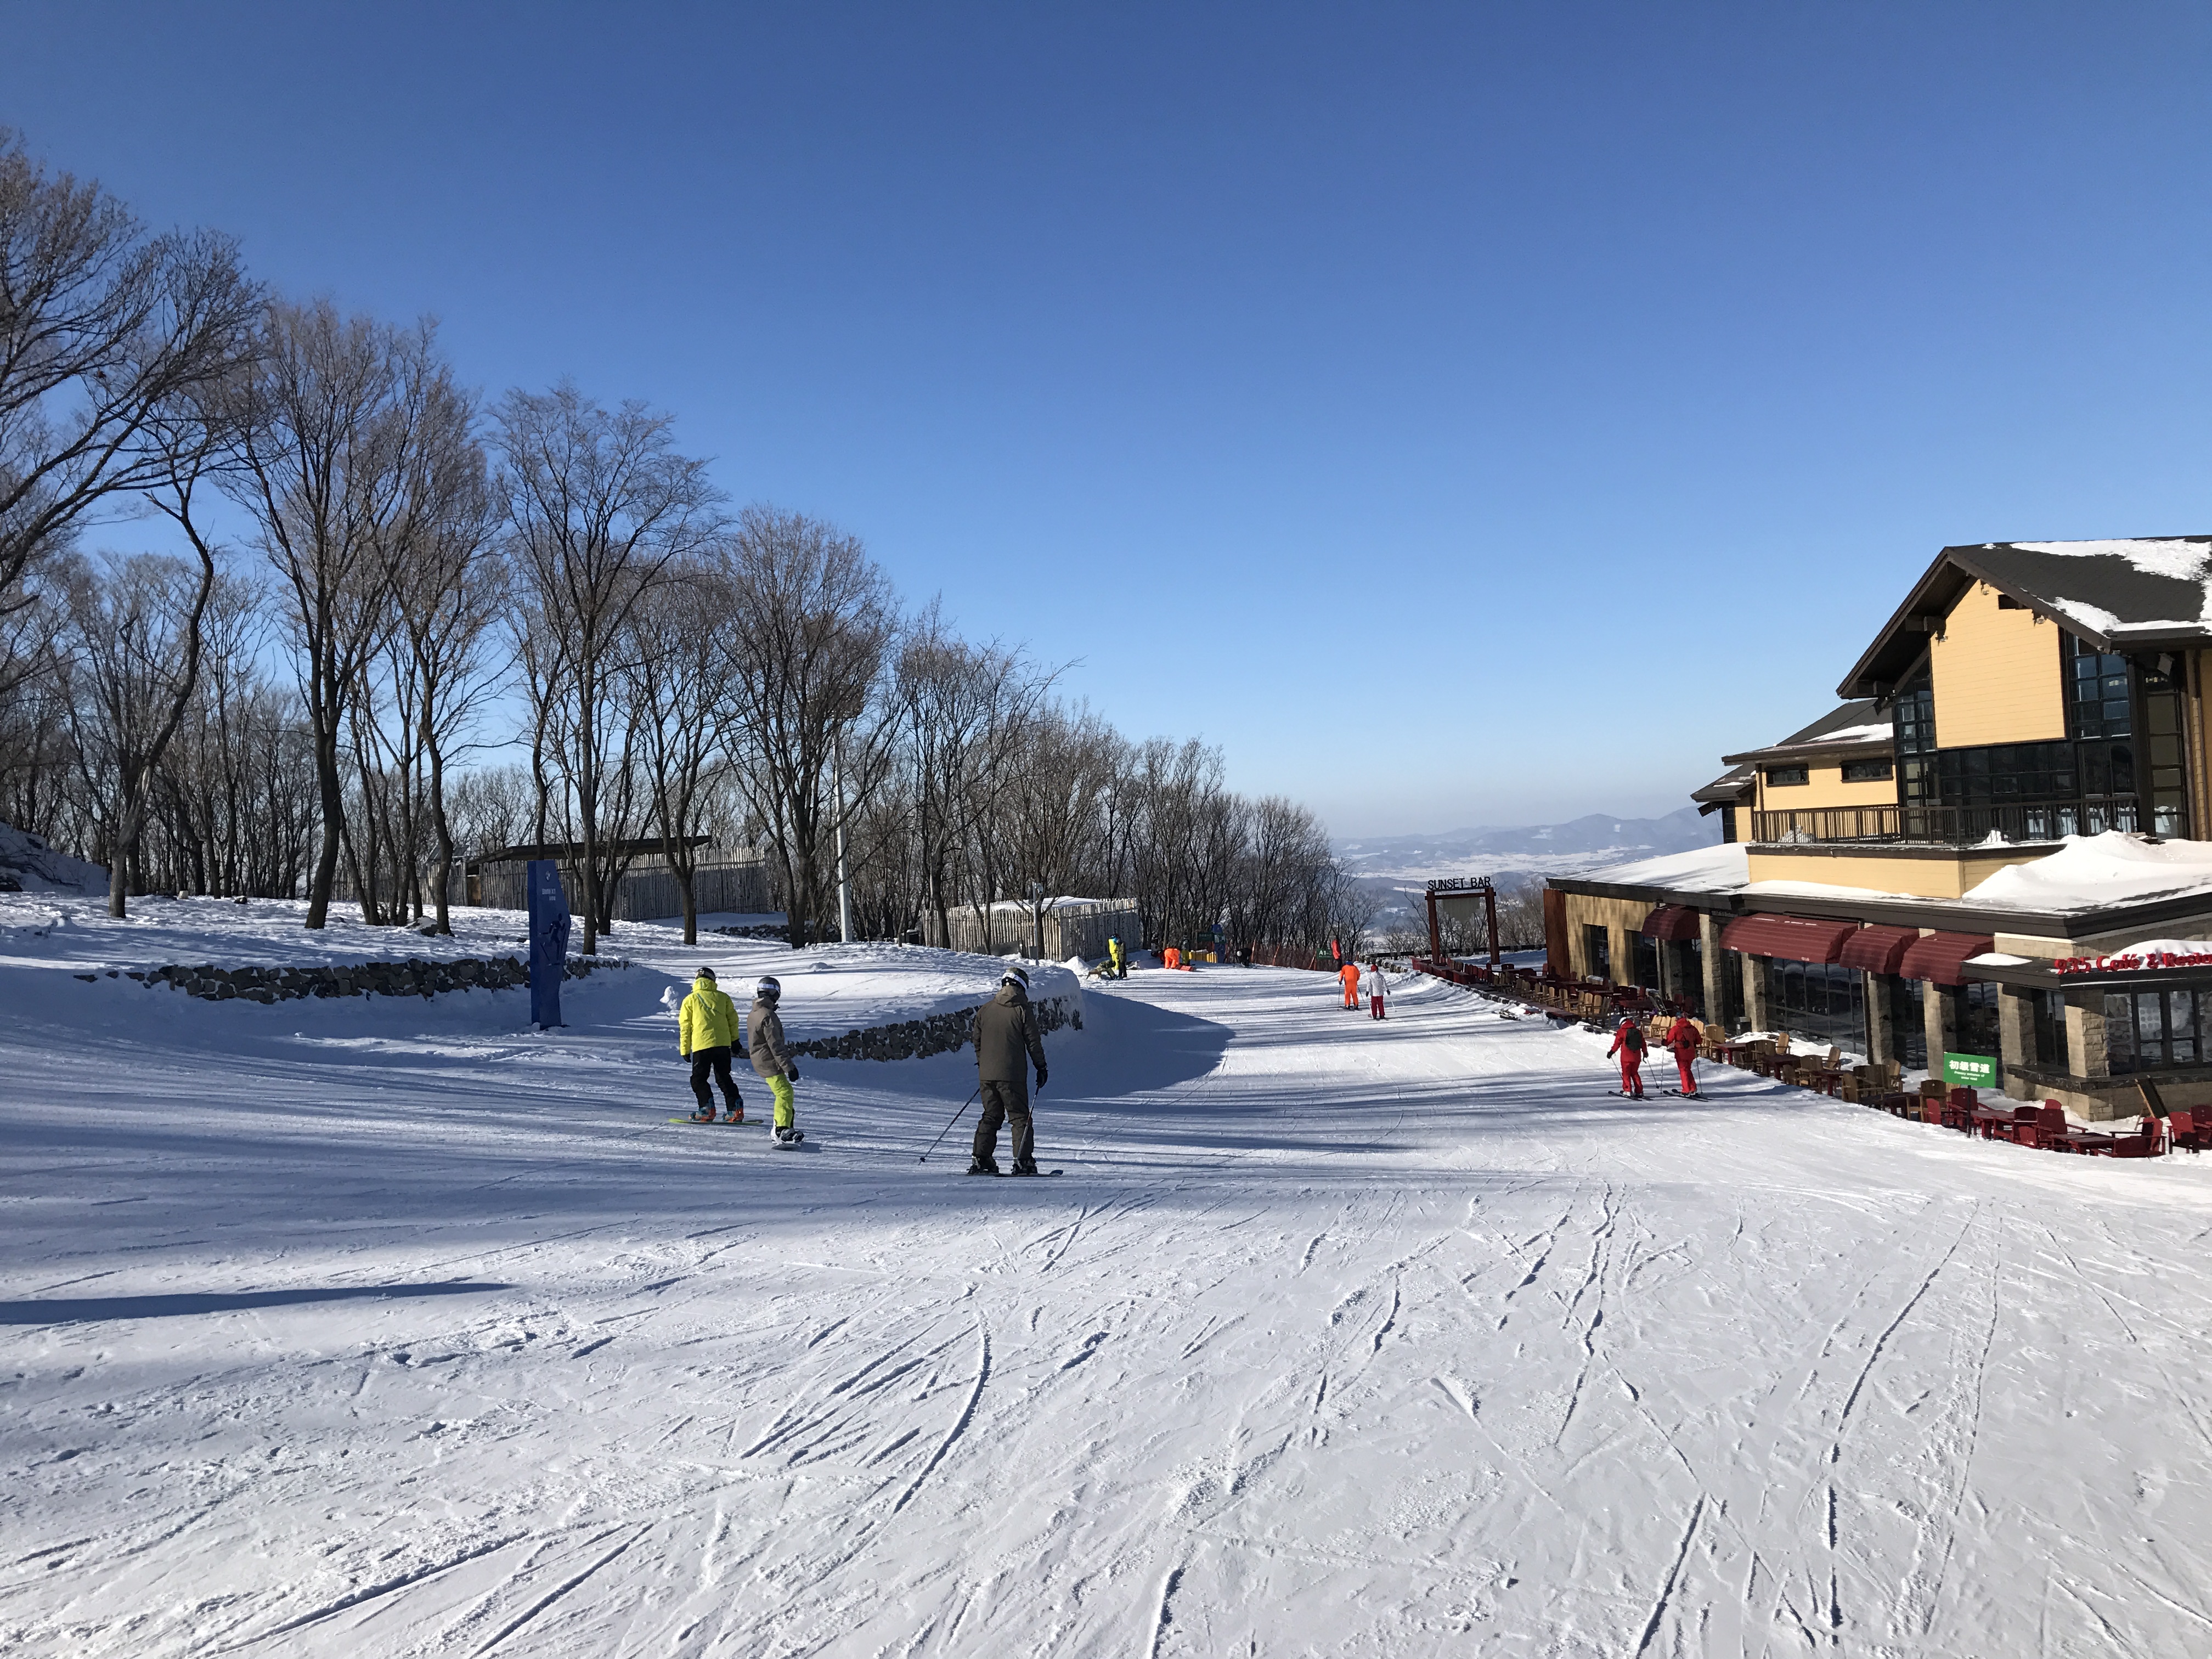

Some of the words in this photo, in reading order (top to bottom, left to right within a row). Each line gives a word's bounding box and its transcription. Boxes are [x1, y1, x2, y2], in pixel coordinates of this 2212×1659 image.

[1427, 878, 1465, 890] SUNSET
[1471, 877, 1491, 887] BAR
[2054, 957, 2092, 974] 935
[2096, 953, 2141, 972] Café
[2146, 953, 2159, 969] &
[1949, 1060, 1990, 1074] 初级雪道
